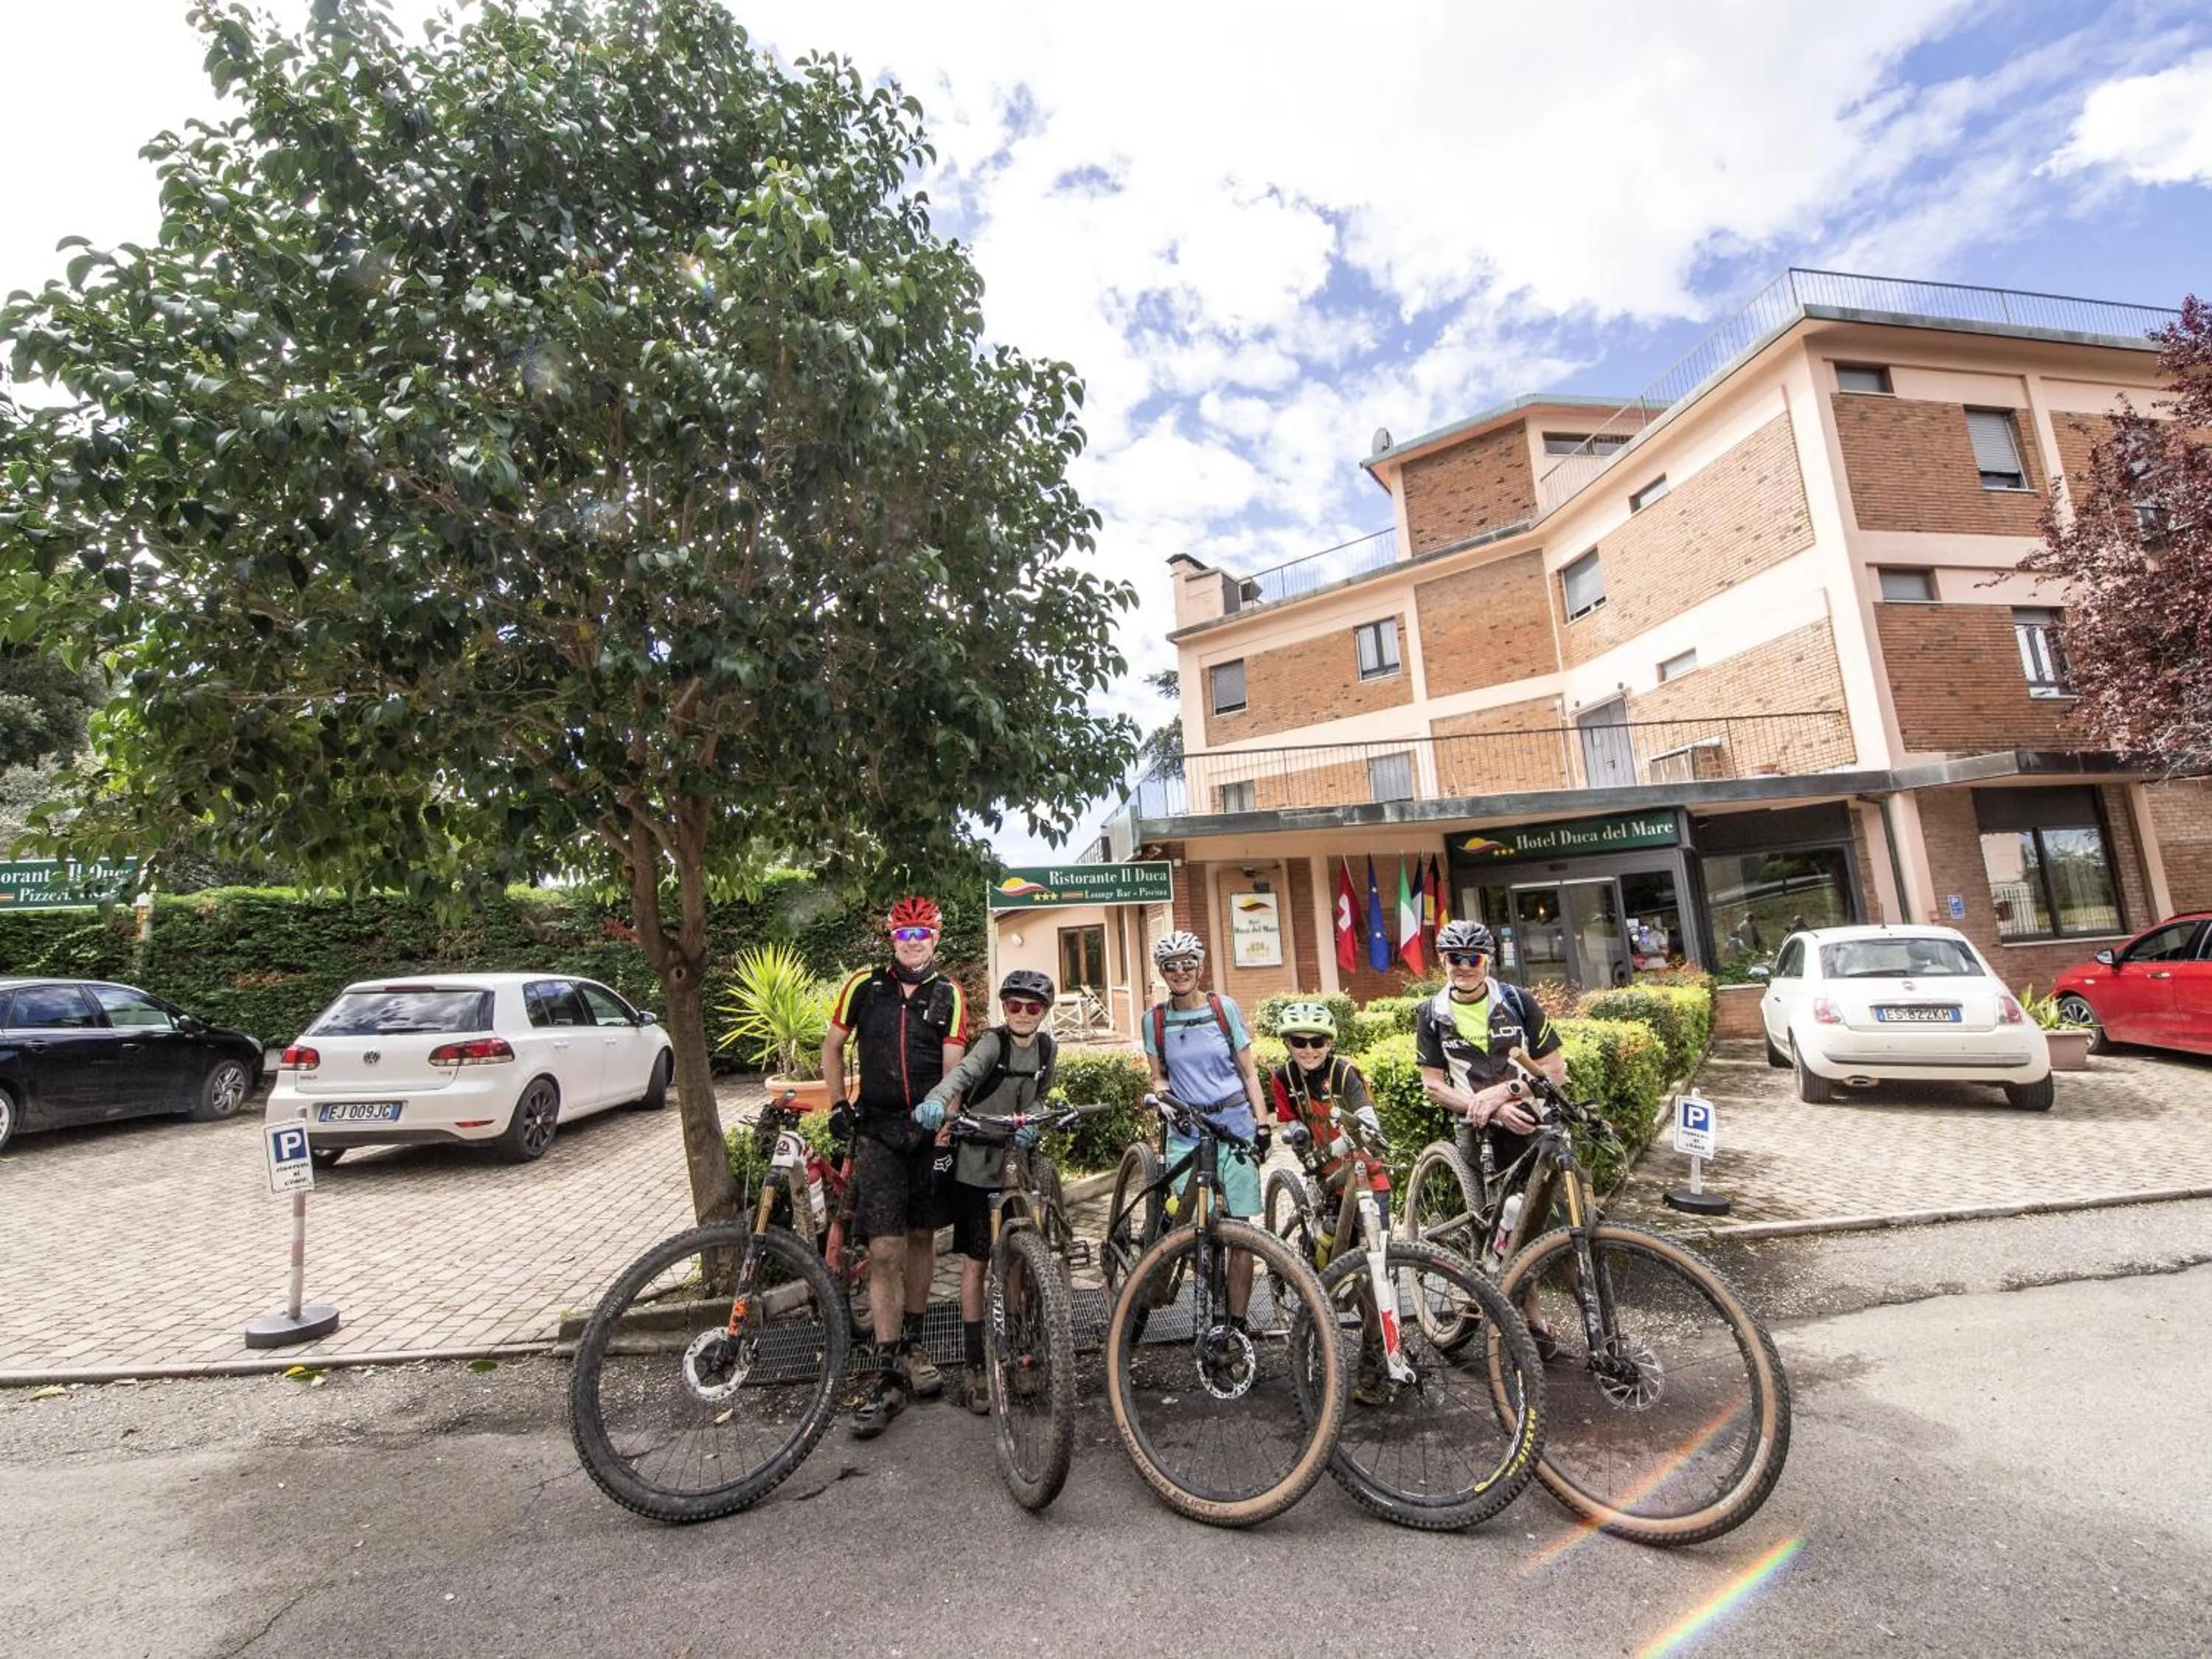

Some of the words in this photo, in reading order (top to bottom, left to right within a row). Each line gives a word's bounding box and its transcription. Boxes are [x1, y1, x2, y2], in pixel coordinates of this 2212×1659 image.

[1516, 831, 1556, 849] Hotel
[1560, 830, 1598, 846] Duca
[1602, 823, 1627, 840] del
[1632, 821, 1674, 838] Mare
[1, 868, 51, 884] orant
[1048, 870, 1117, 886] Ristorante
[1121, 868, 1132, 883] Il
[1135, 868, 1167, 882] Duca
[1116, 888, 1131, 897] Bar
[1688, 1106, 1705, 1127] P
[280, 1132, 302, 1159] P
